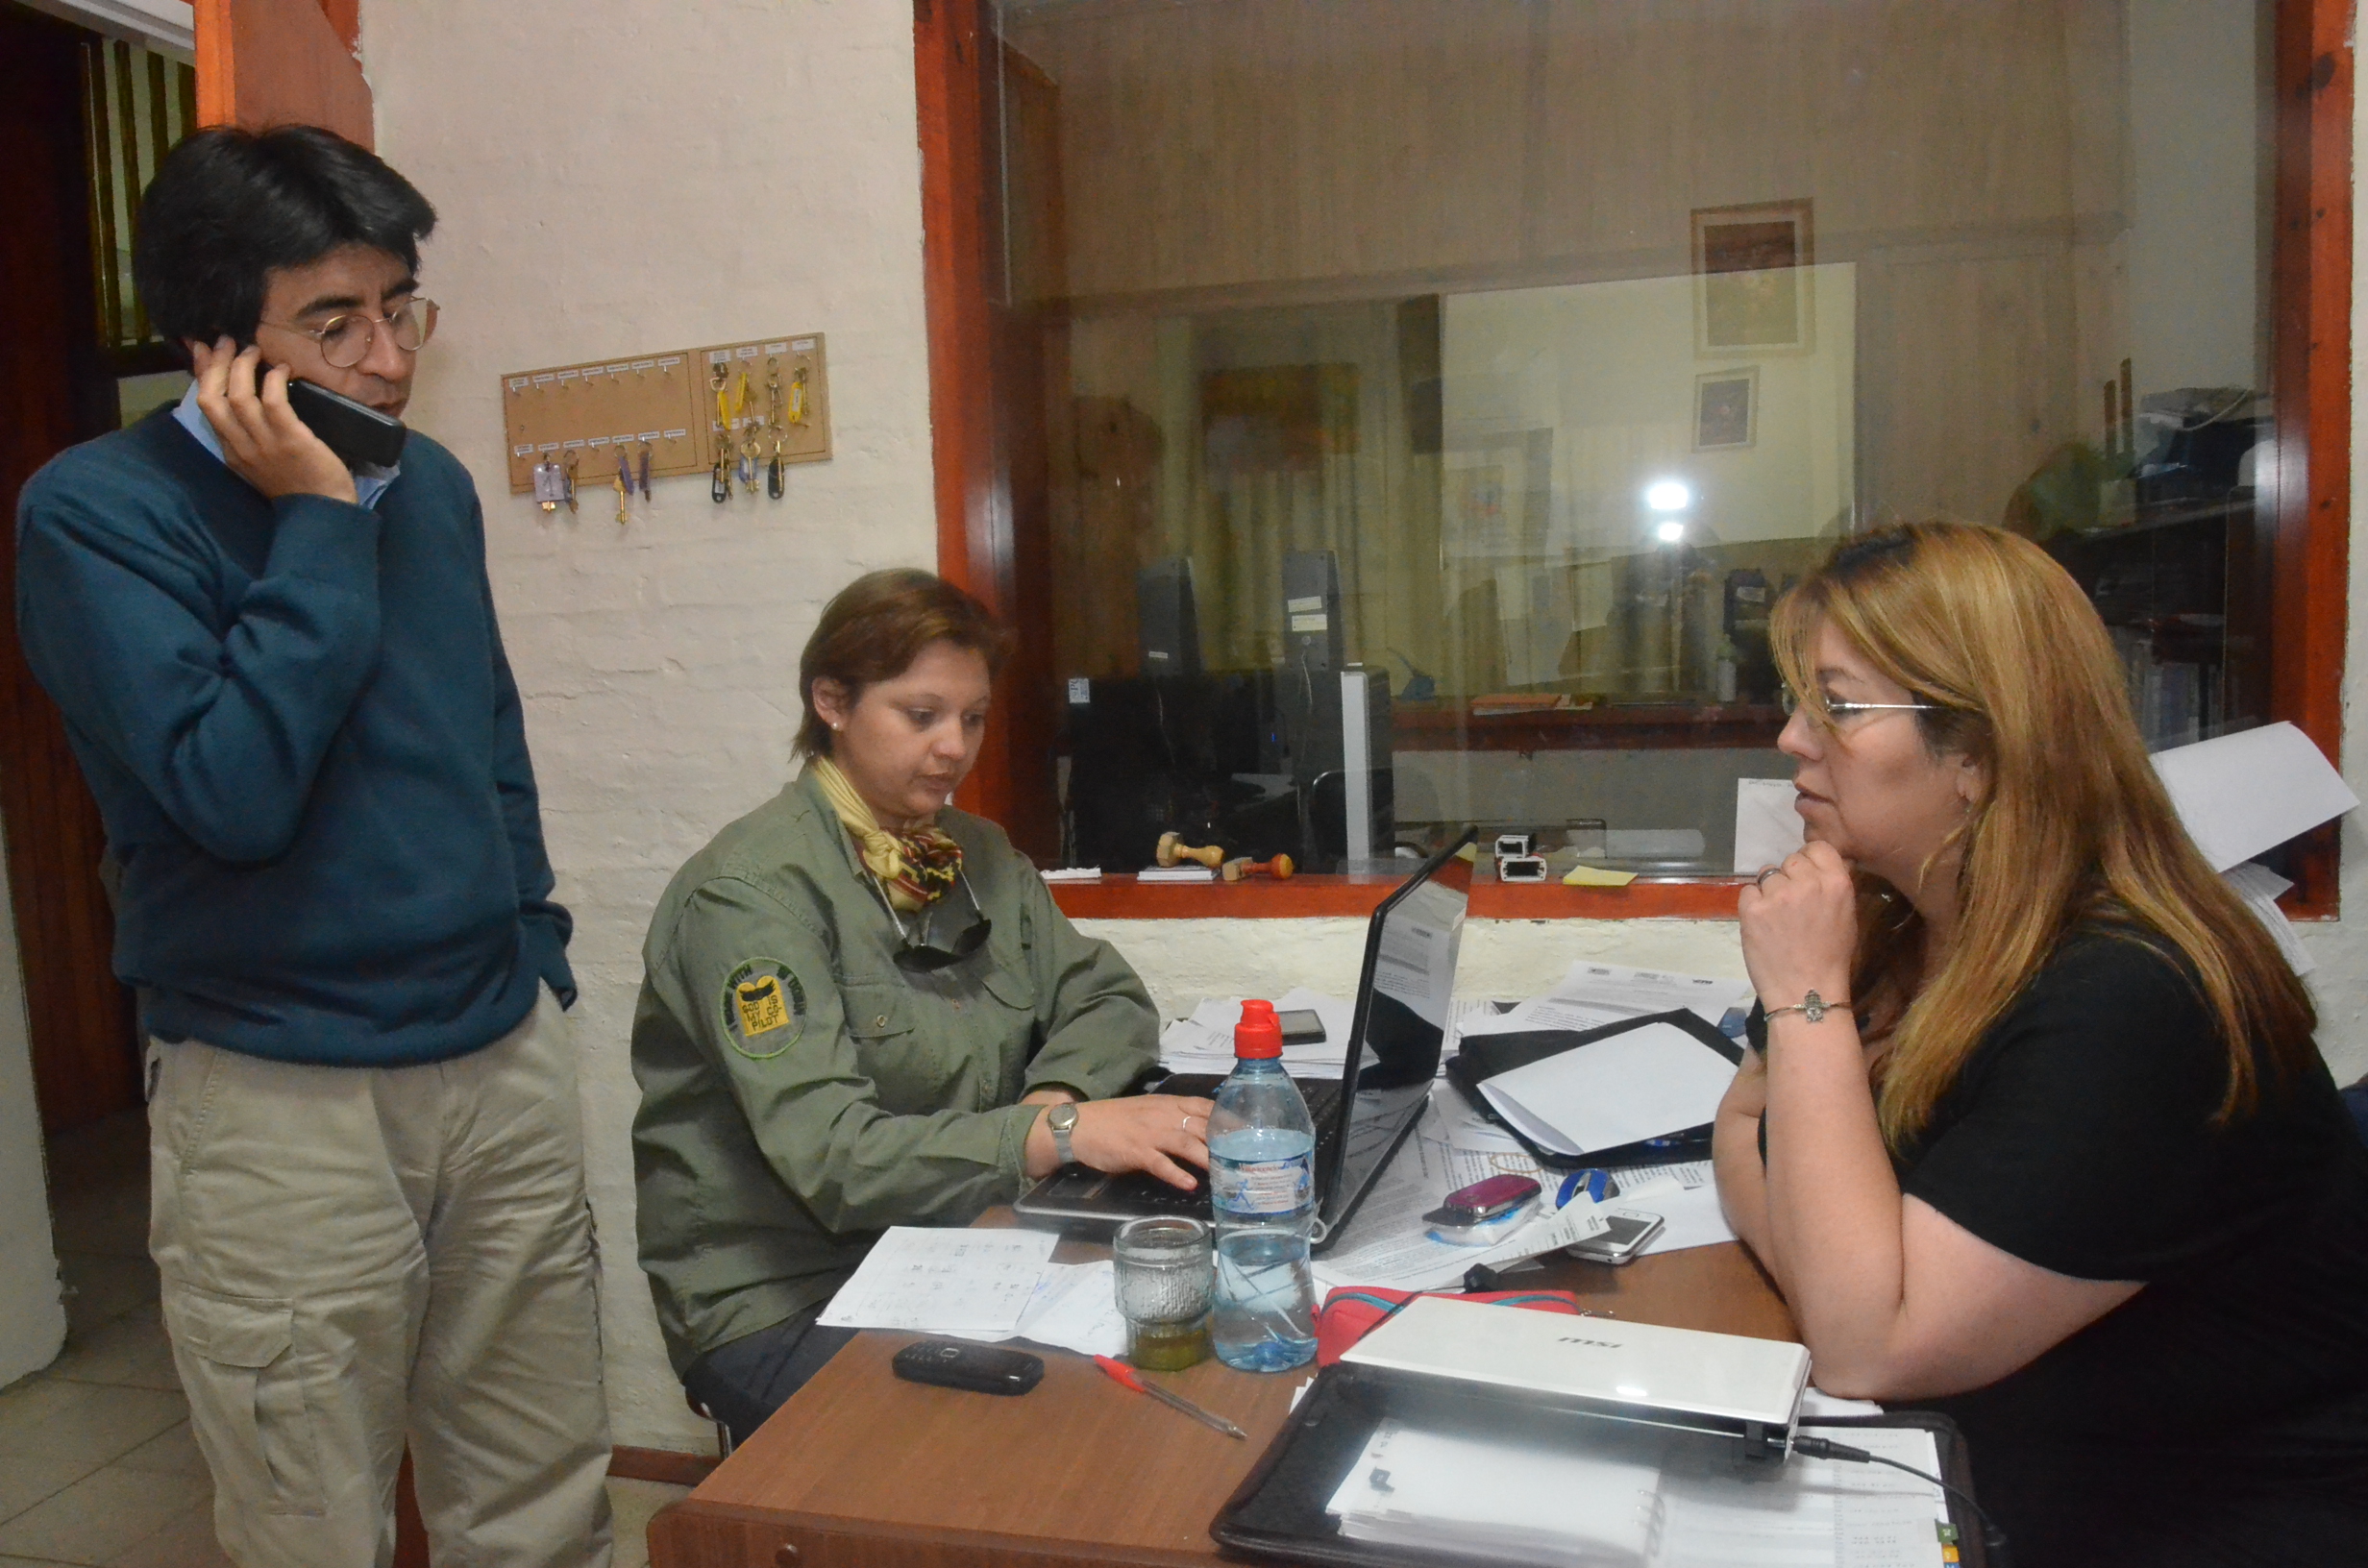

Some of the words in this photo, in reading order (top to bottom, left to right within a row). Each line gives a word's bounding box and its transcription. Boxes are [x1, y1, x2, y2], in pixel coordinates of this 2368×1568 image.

[742, 1001, 760, 1014] GOD
[768, 994, 778, 1005] IS
[746, 1011, 760, 1022] MY
[752, 1014, 779, 1031] PILOT
[1557, 1336, 1623, 1349] msi
